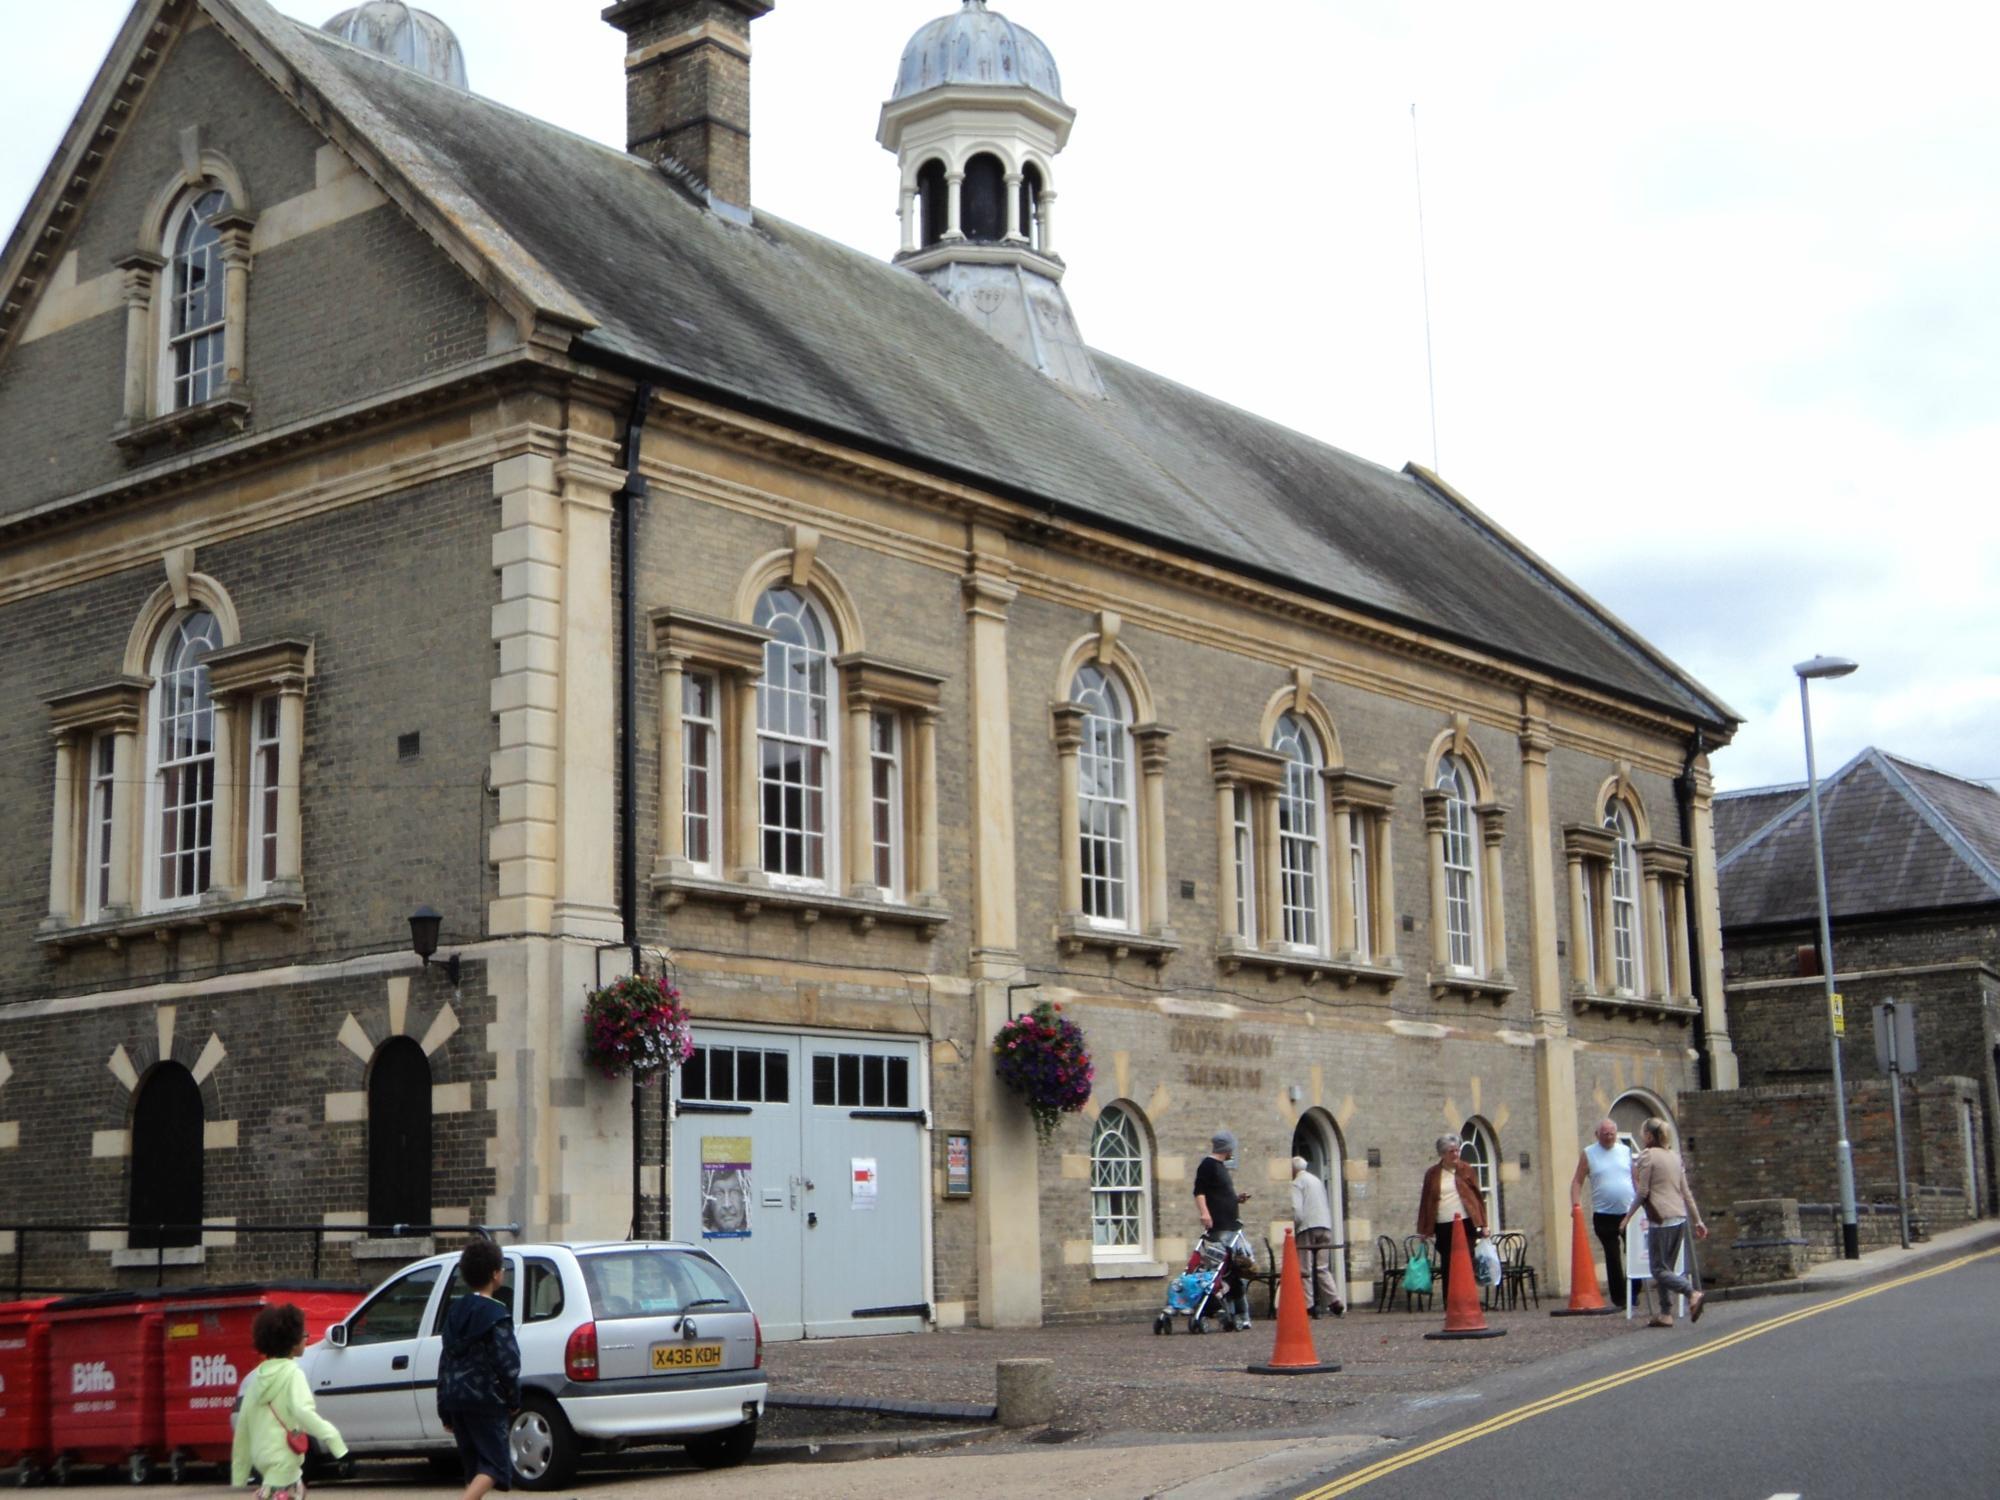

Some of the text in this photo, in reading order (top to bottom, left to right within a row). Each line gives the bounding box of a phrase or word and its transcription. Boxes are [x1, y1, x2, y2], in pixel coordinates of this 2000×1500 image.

[1224, 1032, 1275, 1057] ARMY
[1183, 1064, 1262, 1090] MUSEUM
[656, 1346, 721, 1366] X436 KDH
[72, 1361, 115, 1393] Biffa
[190, 1354, 237, 1387] Biffa
